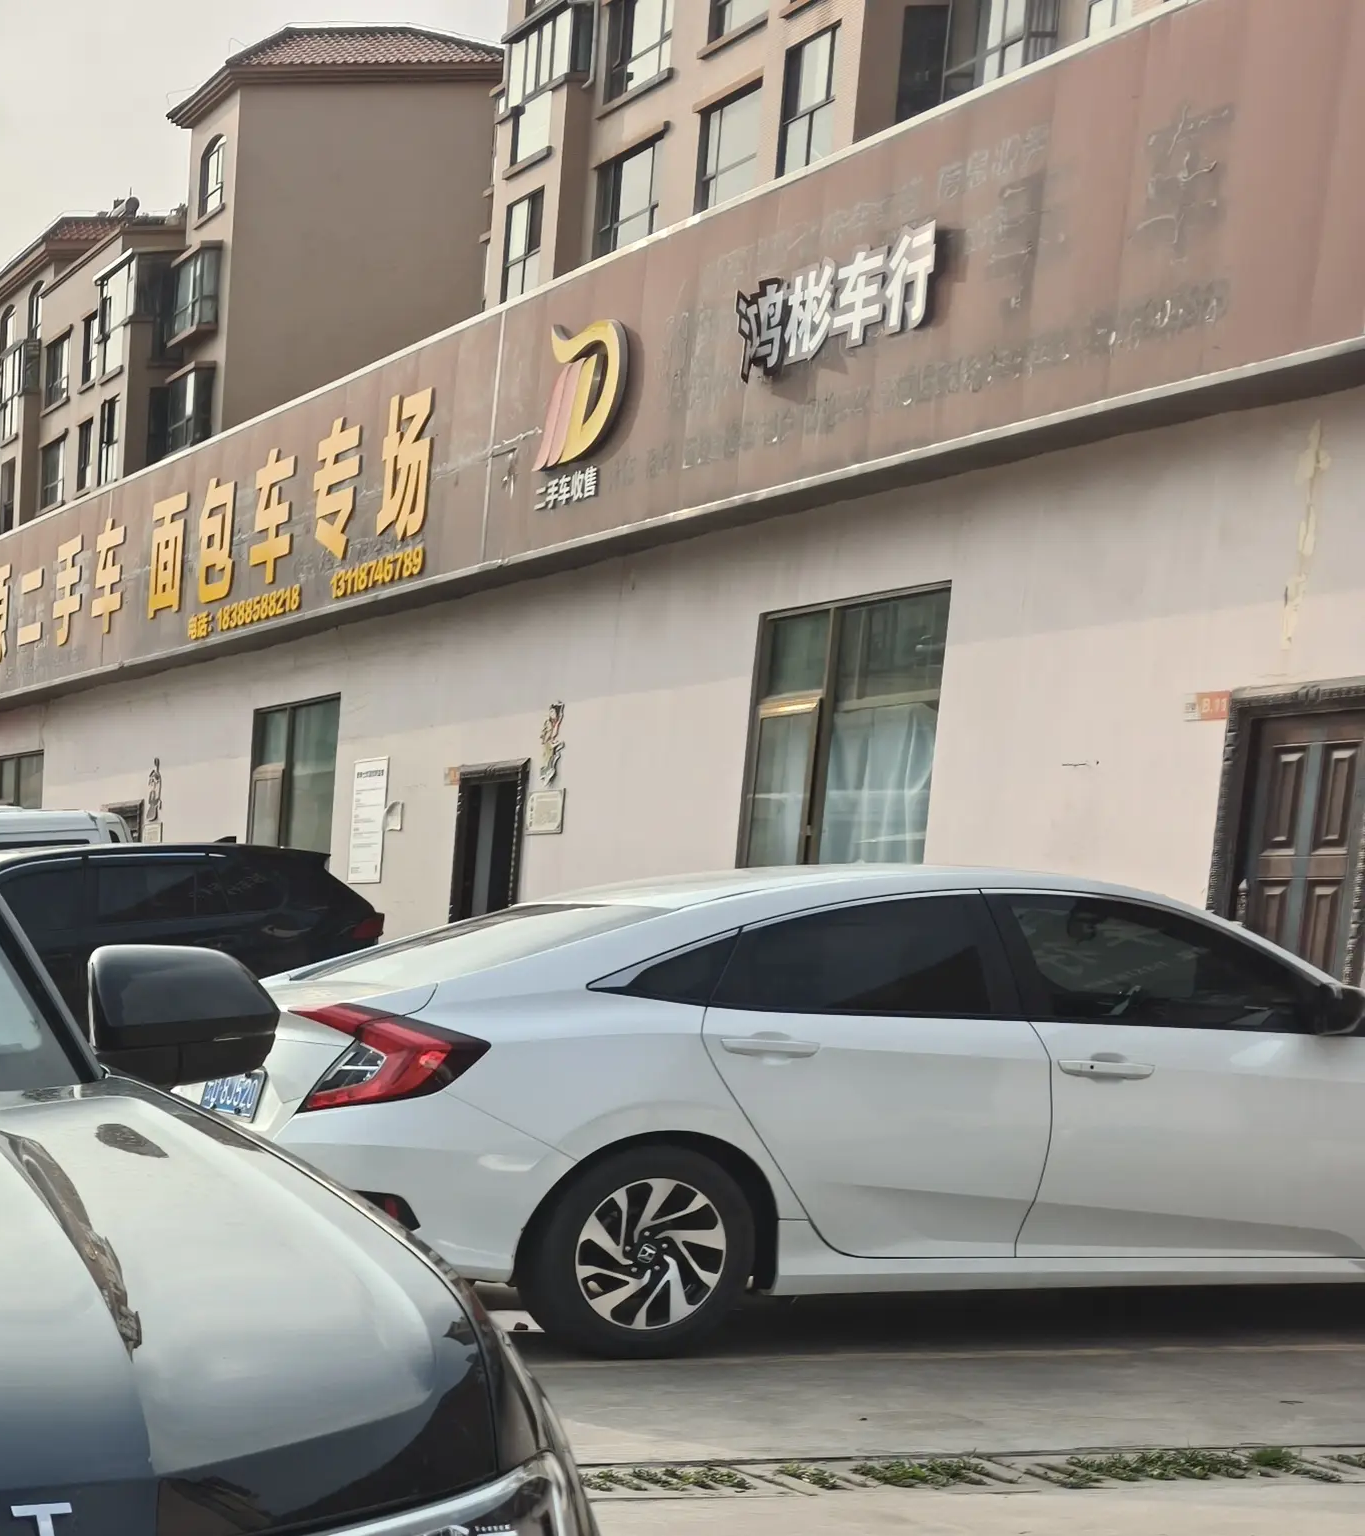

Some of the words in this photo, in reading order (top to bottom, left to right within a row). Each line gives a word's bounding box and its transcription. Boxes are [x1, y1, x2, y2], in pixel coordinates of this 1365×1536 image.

[737, 224, 936, 380] 鸿彬车行
[148, 386, 435, 620] 面包车专场
[533, 466, 599, 511] 二手车收售
[330, 546, 425, 599] 13118746789
